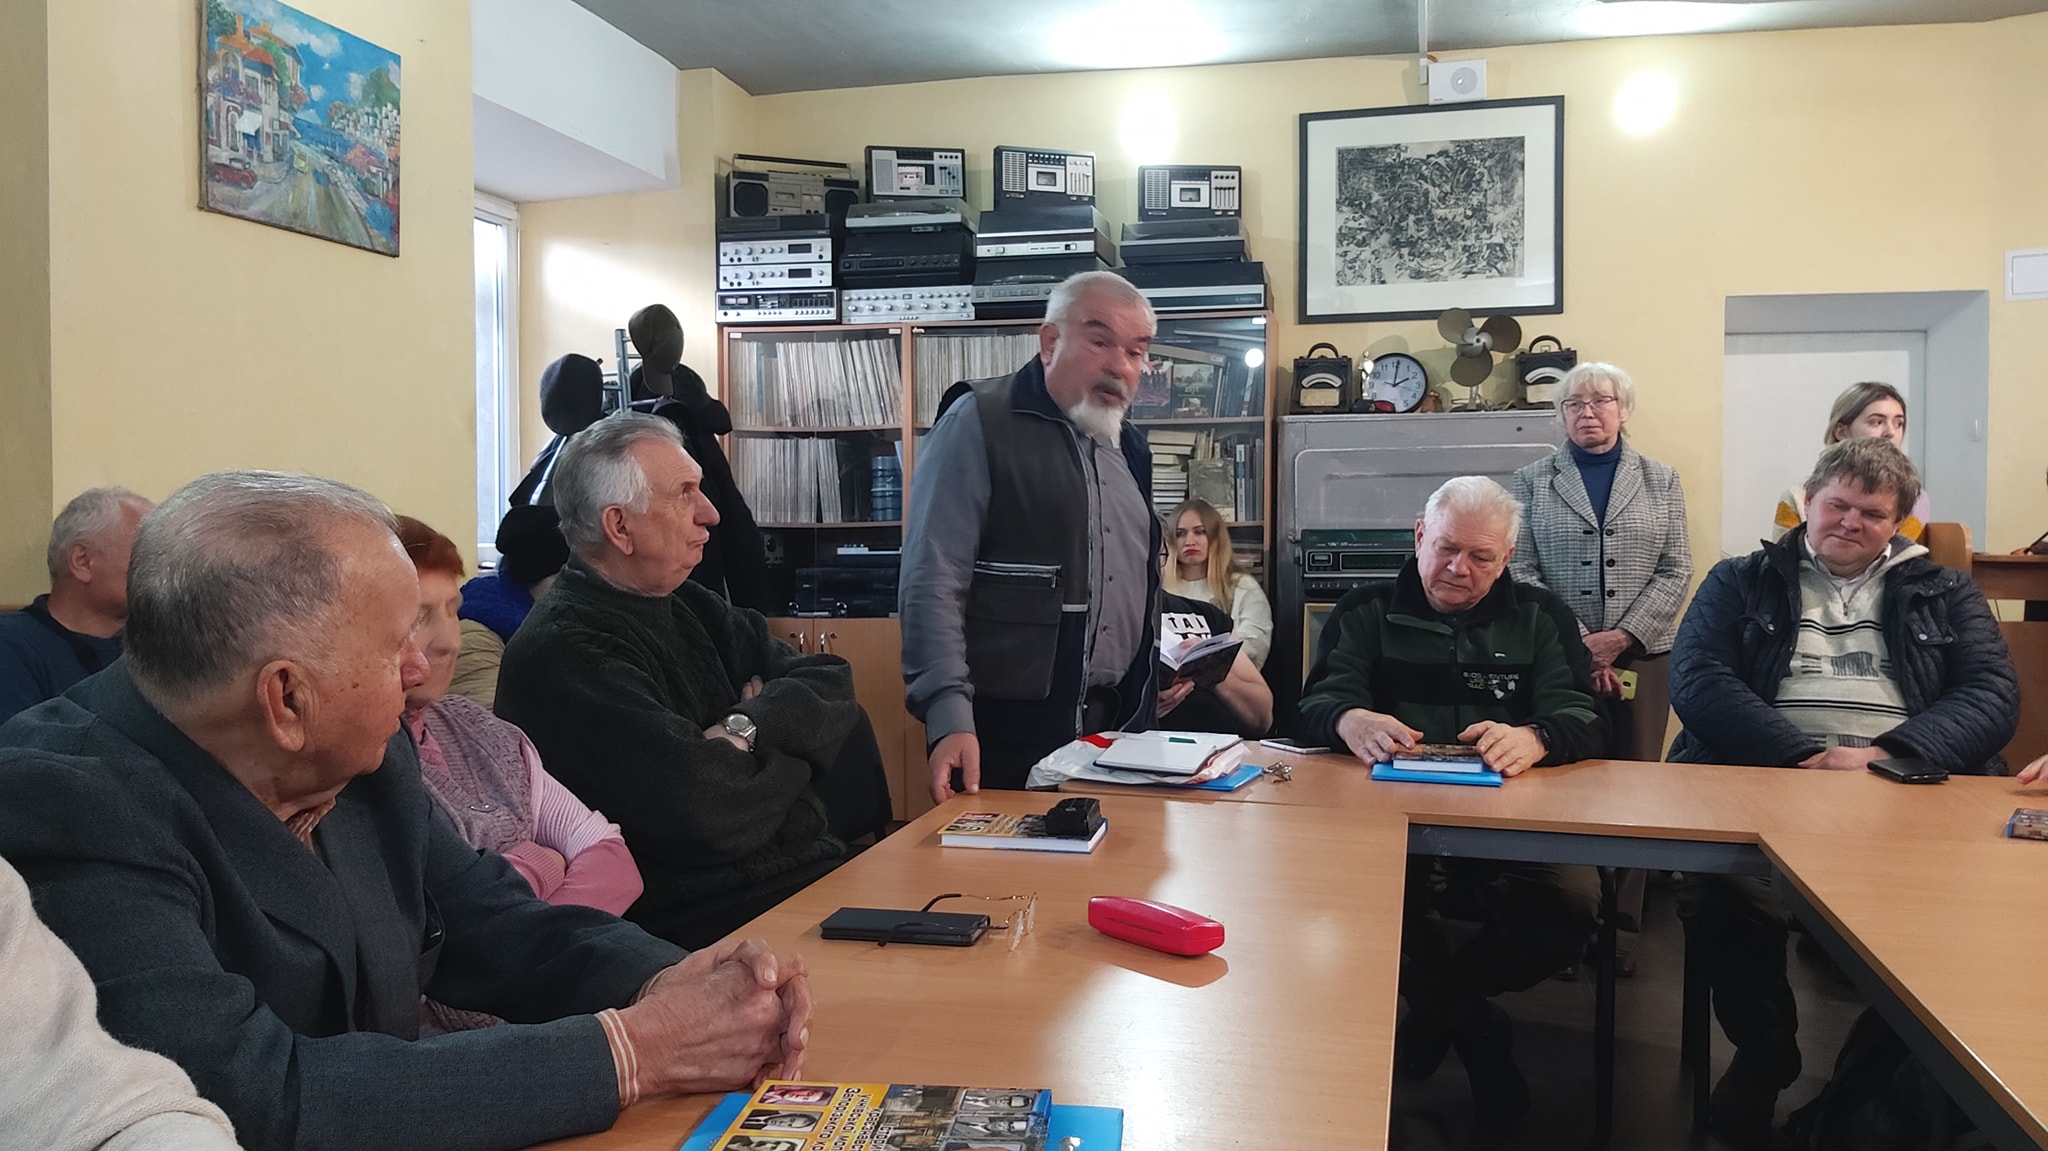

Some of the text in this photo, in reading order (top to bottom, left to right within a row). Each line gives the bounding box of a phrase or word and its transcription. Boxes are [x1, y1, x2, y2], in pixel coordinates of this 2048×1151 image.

[1411, 371, 1418, 380] 2
[1368, 381, 1375, 389] 9
[1415, 381, 1421, 390] 3
[1403, 399, 1409, 408] 5
